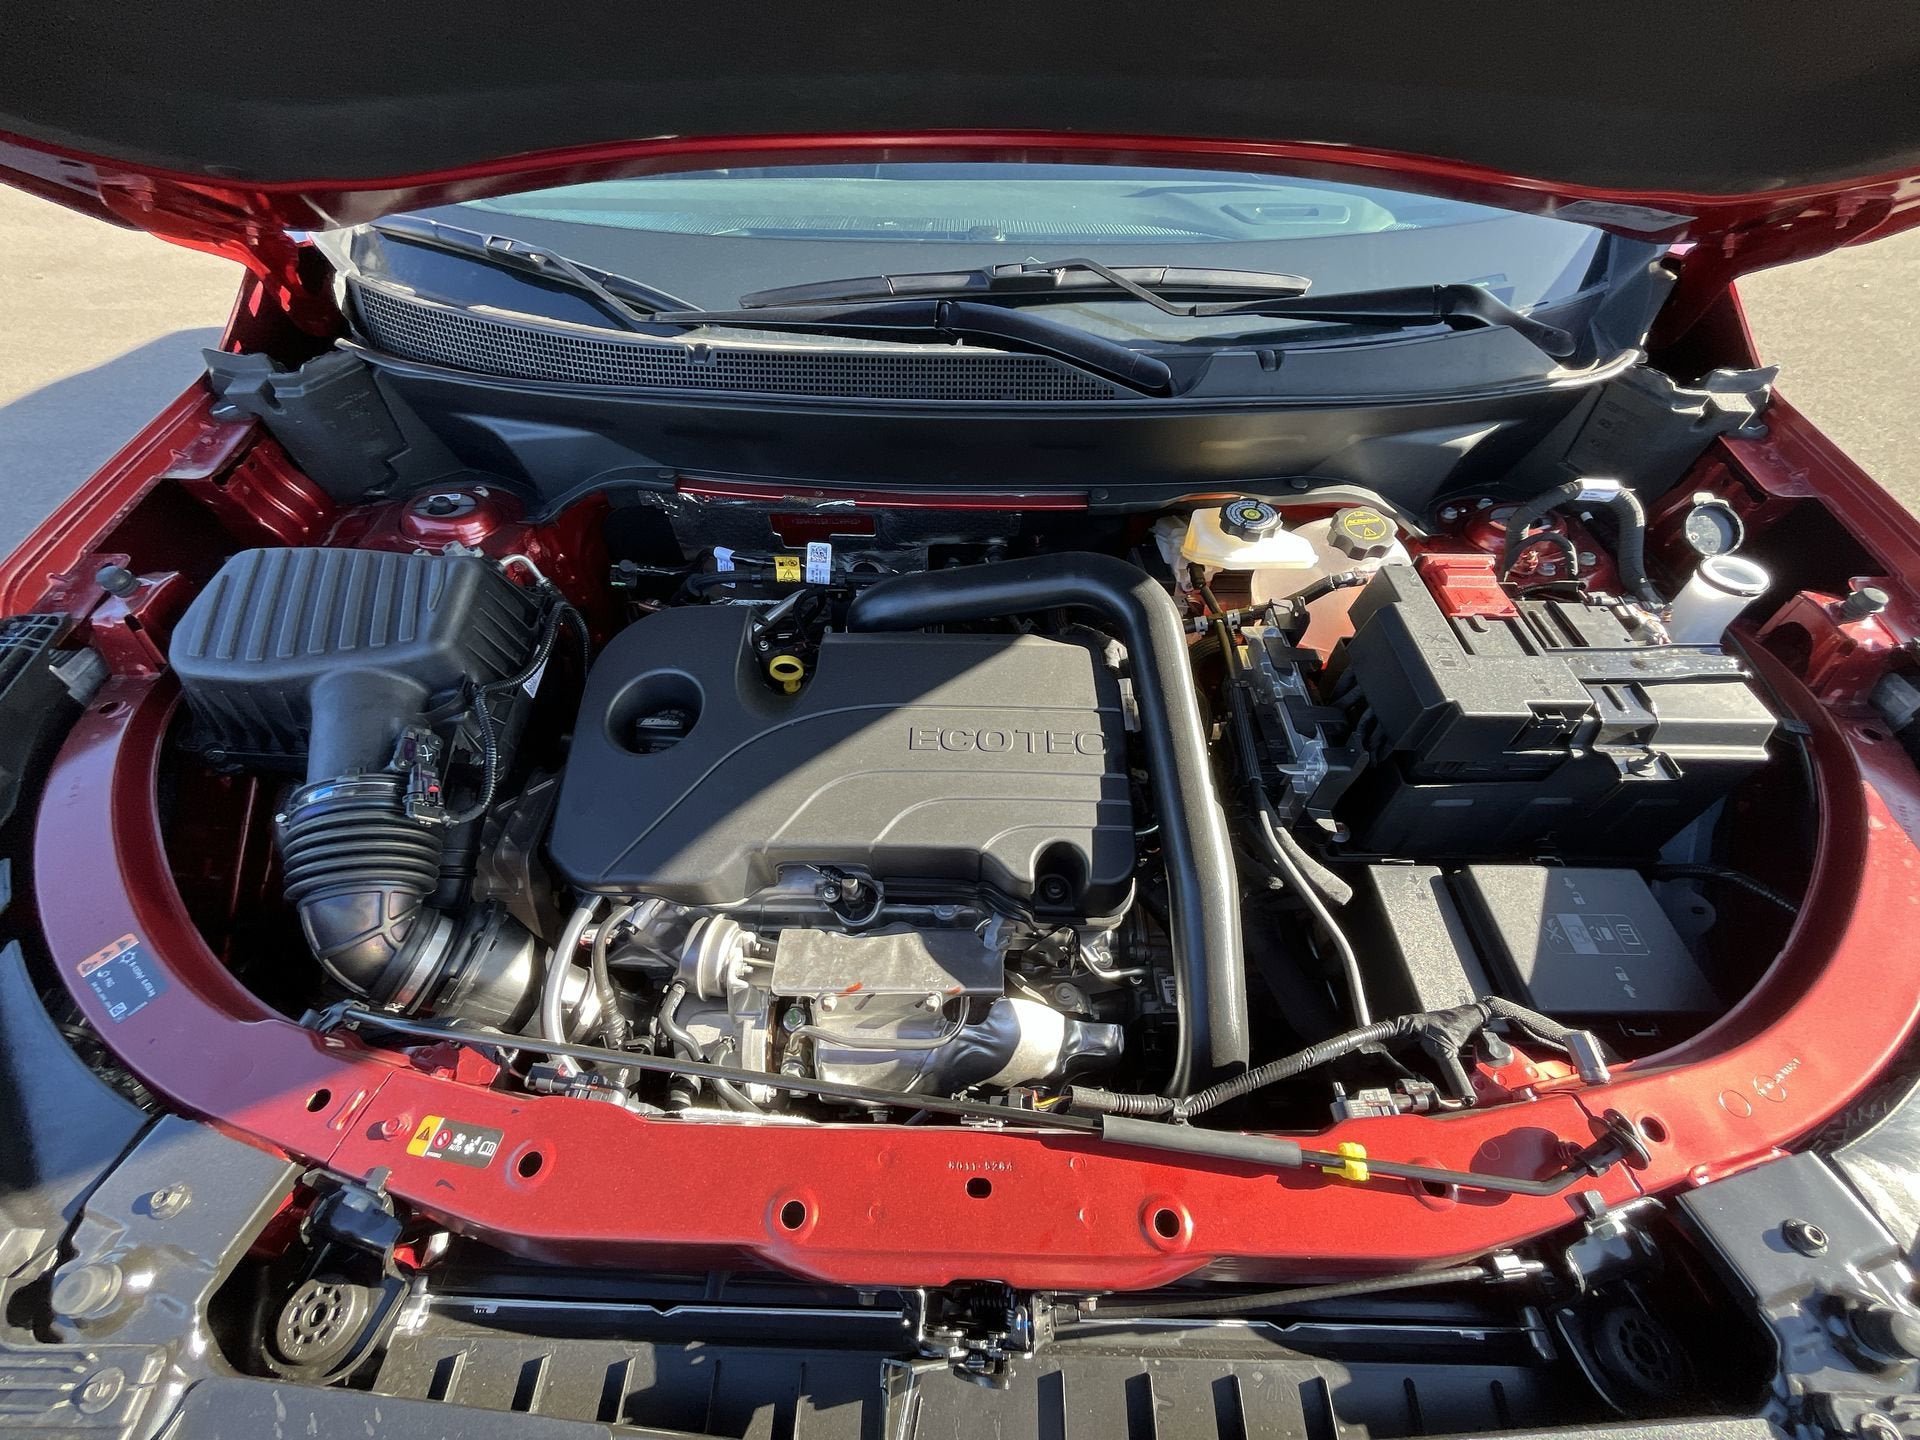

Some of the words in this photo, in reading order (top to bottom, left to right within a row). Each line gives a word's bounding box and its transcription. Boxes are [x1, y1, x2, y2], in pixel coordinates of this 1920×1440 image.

[908, 727, 1107, 755] ECOTEC
[591, 1075, 599, 1083] B
[447, 1143, 462, 1152] AUTO
